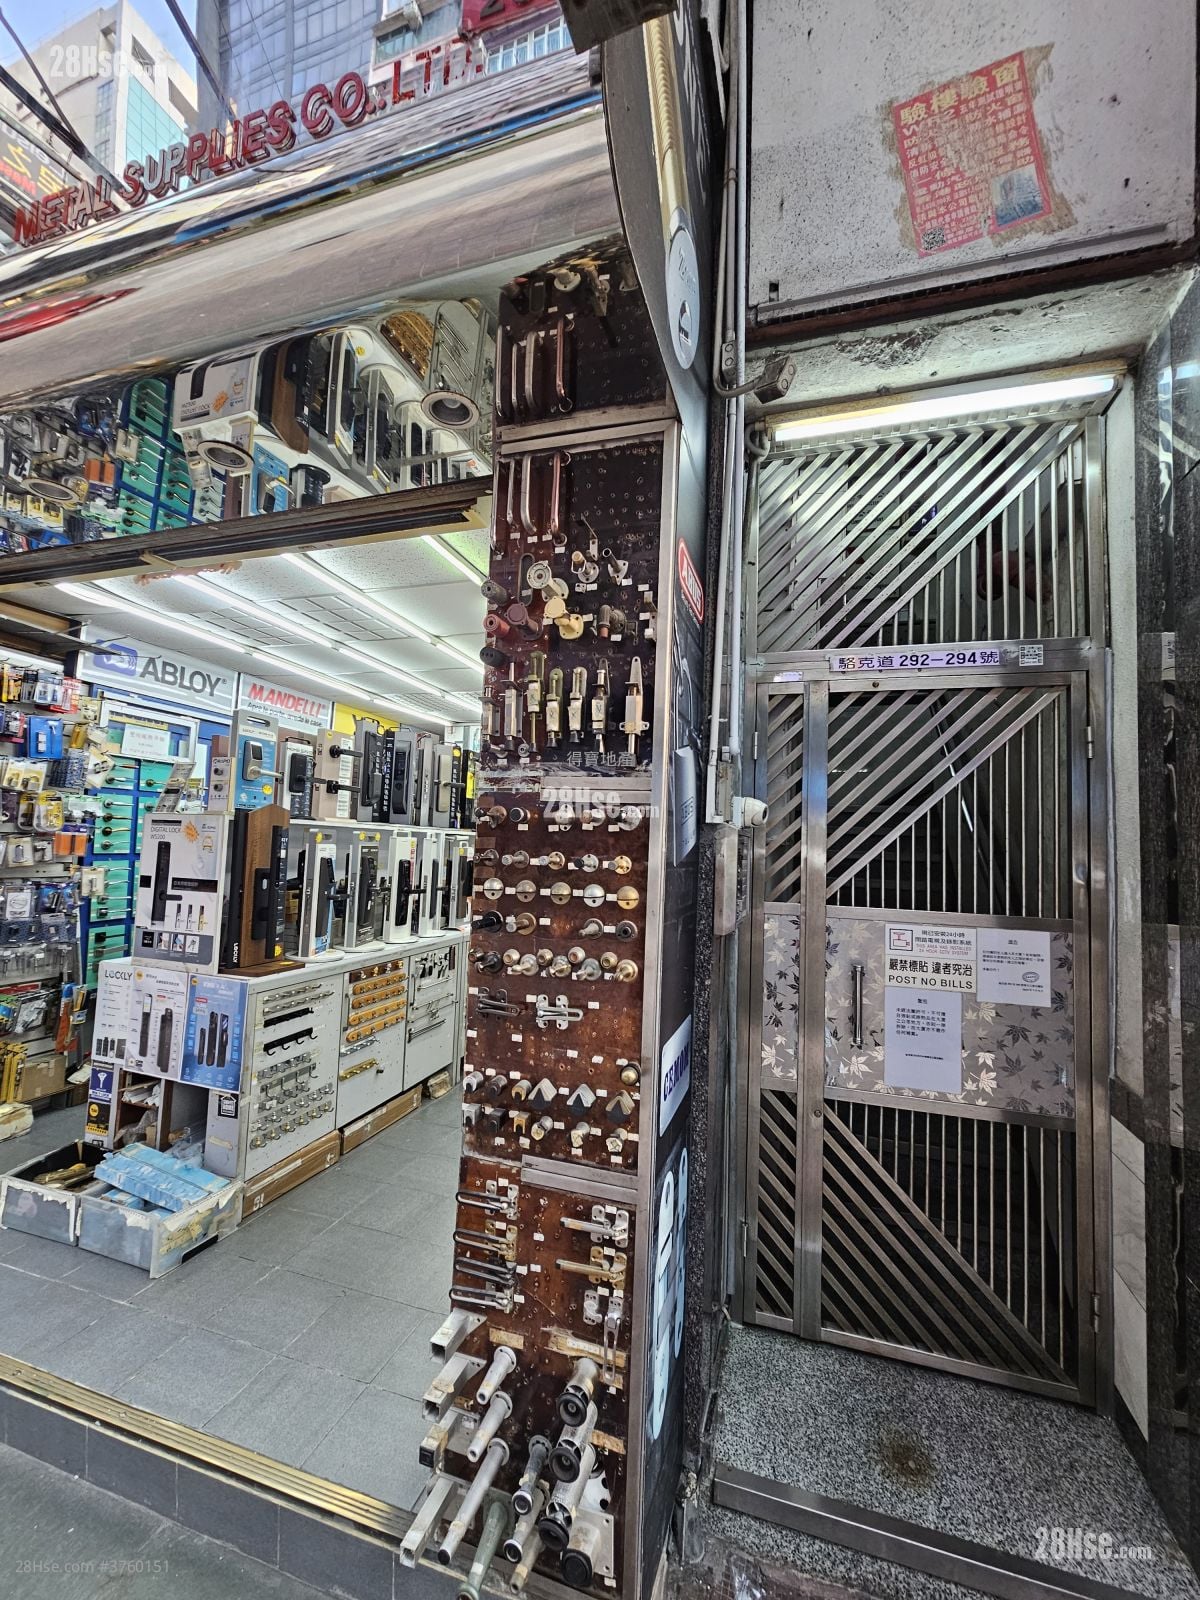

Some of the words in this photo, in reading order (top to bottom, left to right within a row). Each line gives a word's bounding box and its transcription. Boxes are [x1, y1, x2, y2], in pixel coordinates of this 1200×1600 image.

[14, 174, 119, 246] METAL
[119, 100, 297, 207] SUPPLIES
[139, 656, 221, 697] ABLOY
[248, 683, 321, 717] MANDELLI
[888, 975, 916, 985] POST
[920, 977, 937, 987] NO
[940, 979, 973, 989] BILLS
[889, 958, 928, 972] 嚴禁標貼
[931, 961, 972, 977] 違者究治
